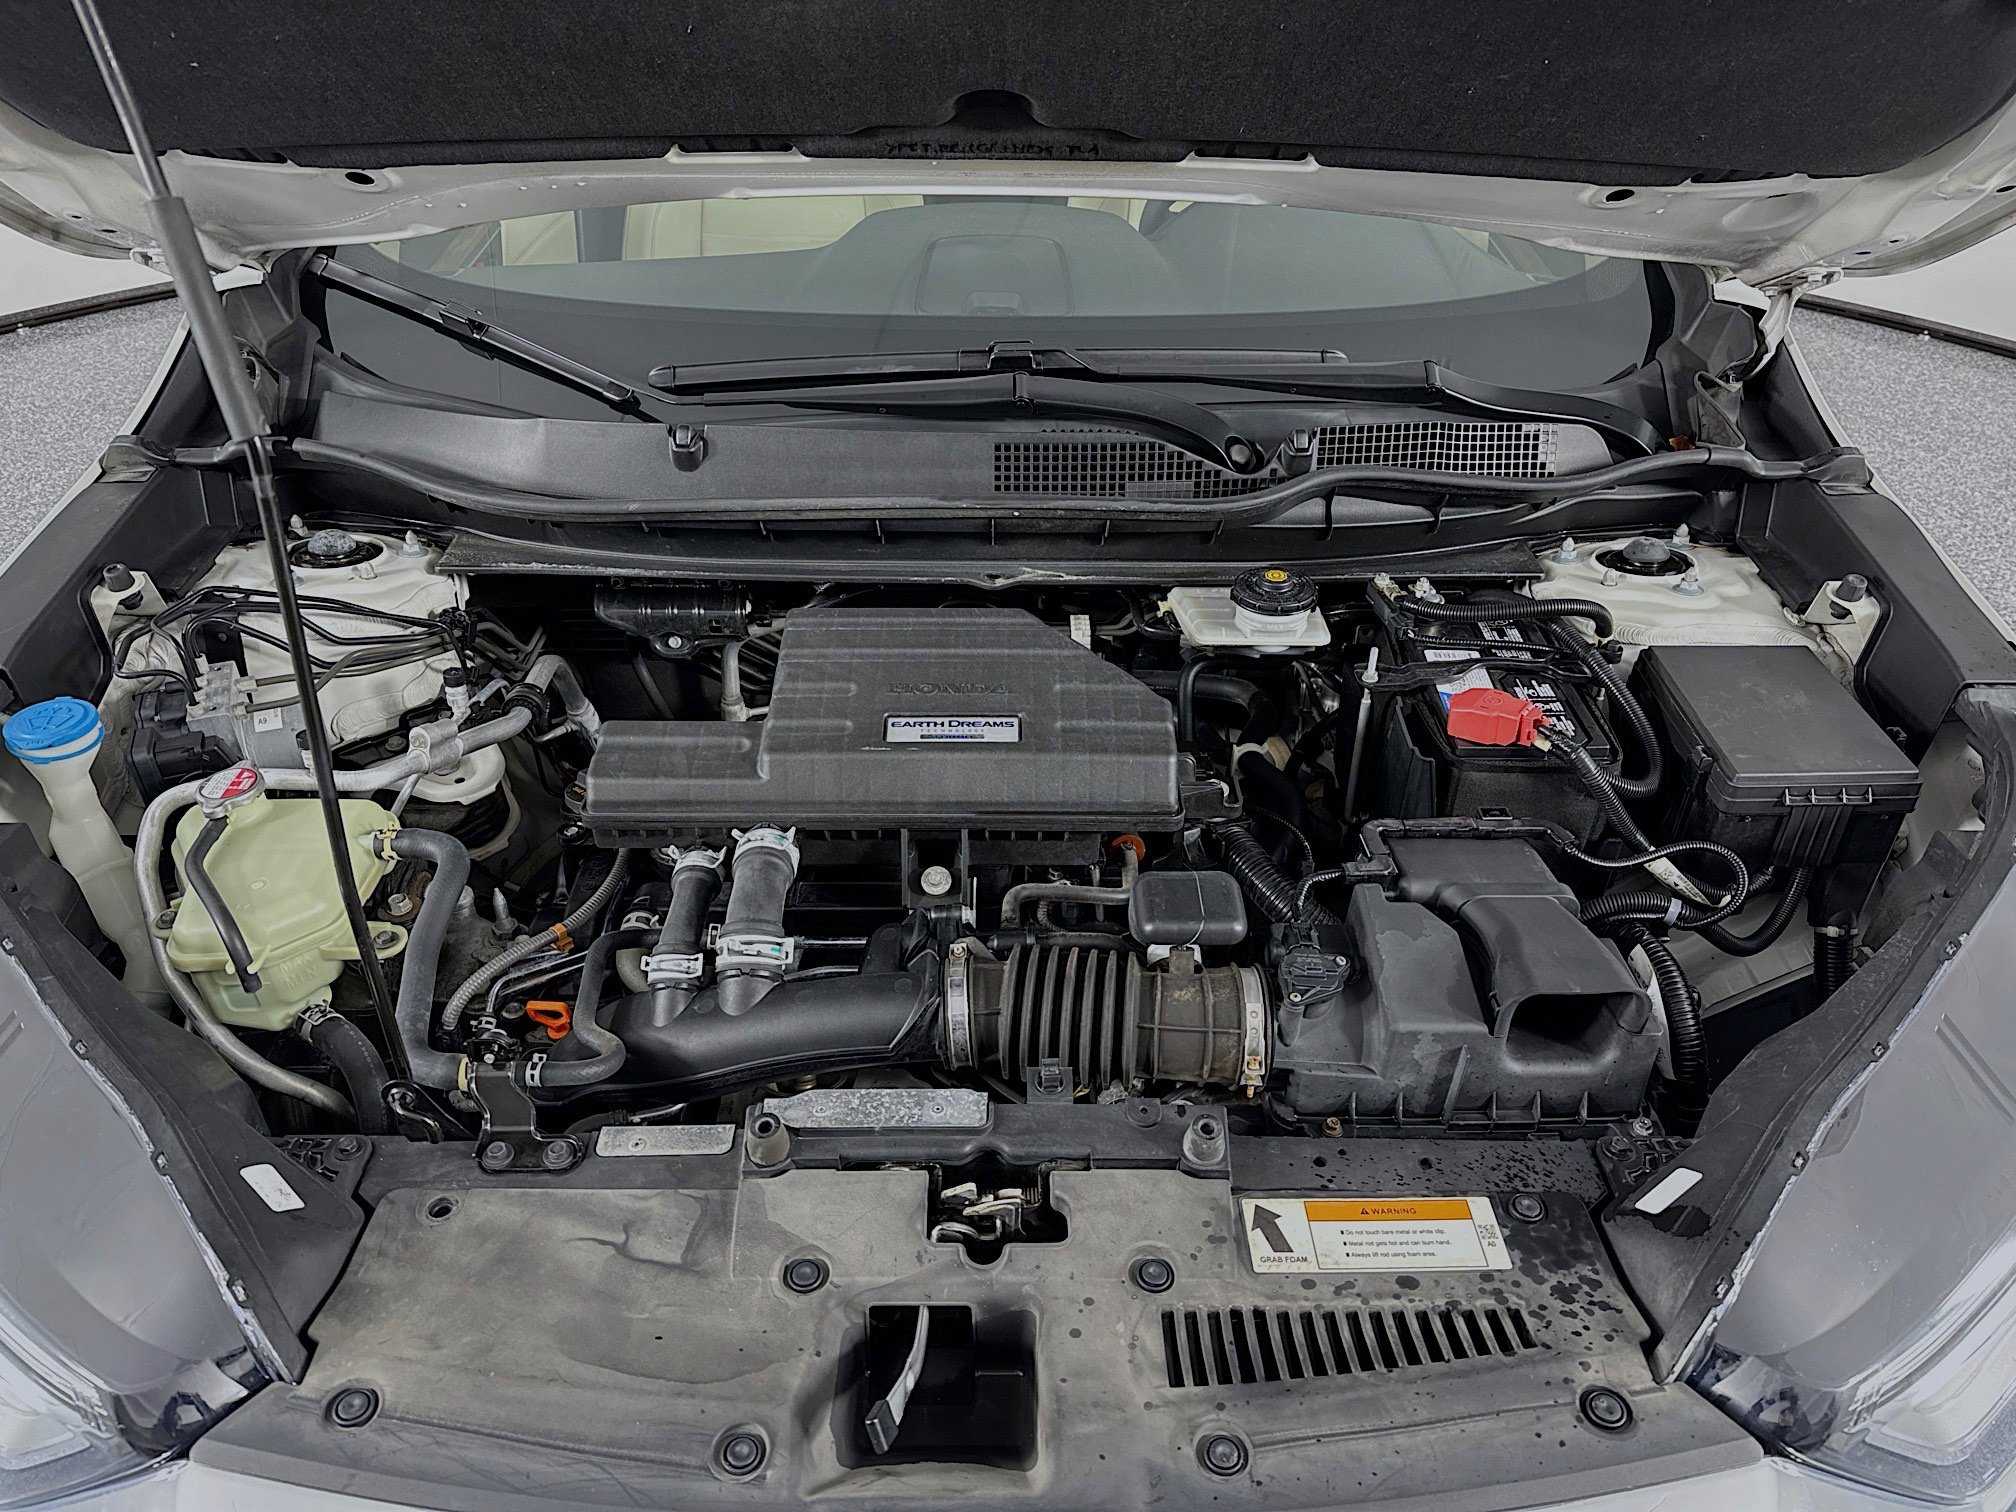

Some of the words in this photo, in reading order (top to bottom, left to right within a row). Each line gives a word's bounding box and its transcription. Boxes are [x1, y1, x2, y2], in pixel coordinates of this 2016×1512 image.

[886, 683, 1011, 695] HONDA
[258, 717, 268, 726] A9
[948, 720, 1015, 728] DREAMS
[284, 965, 319, 990] MIN
